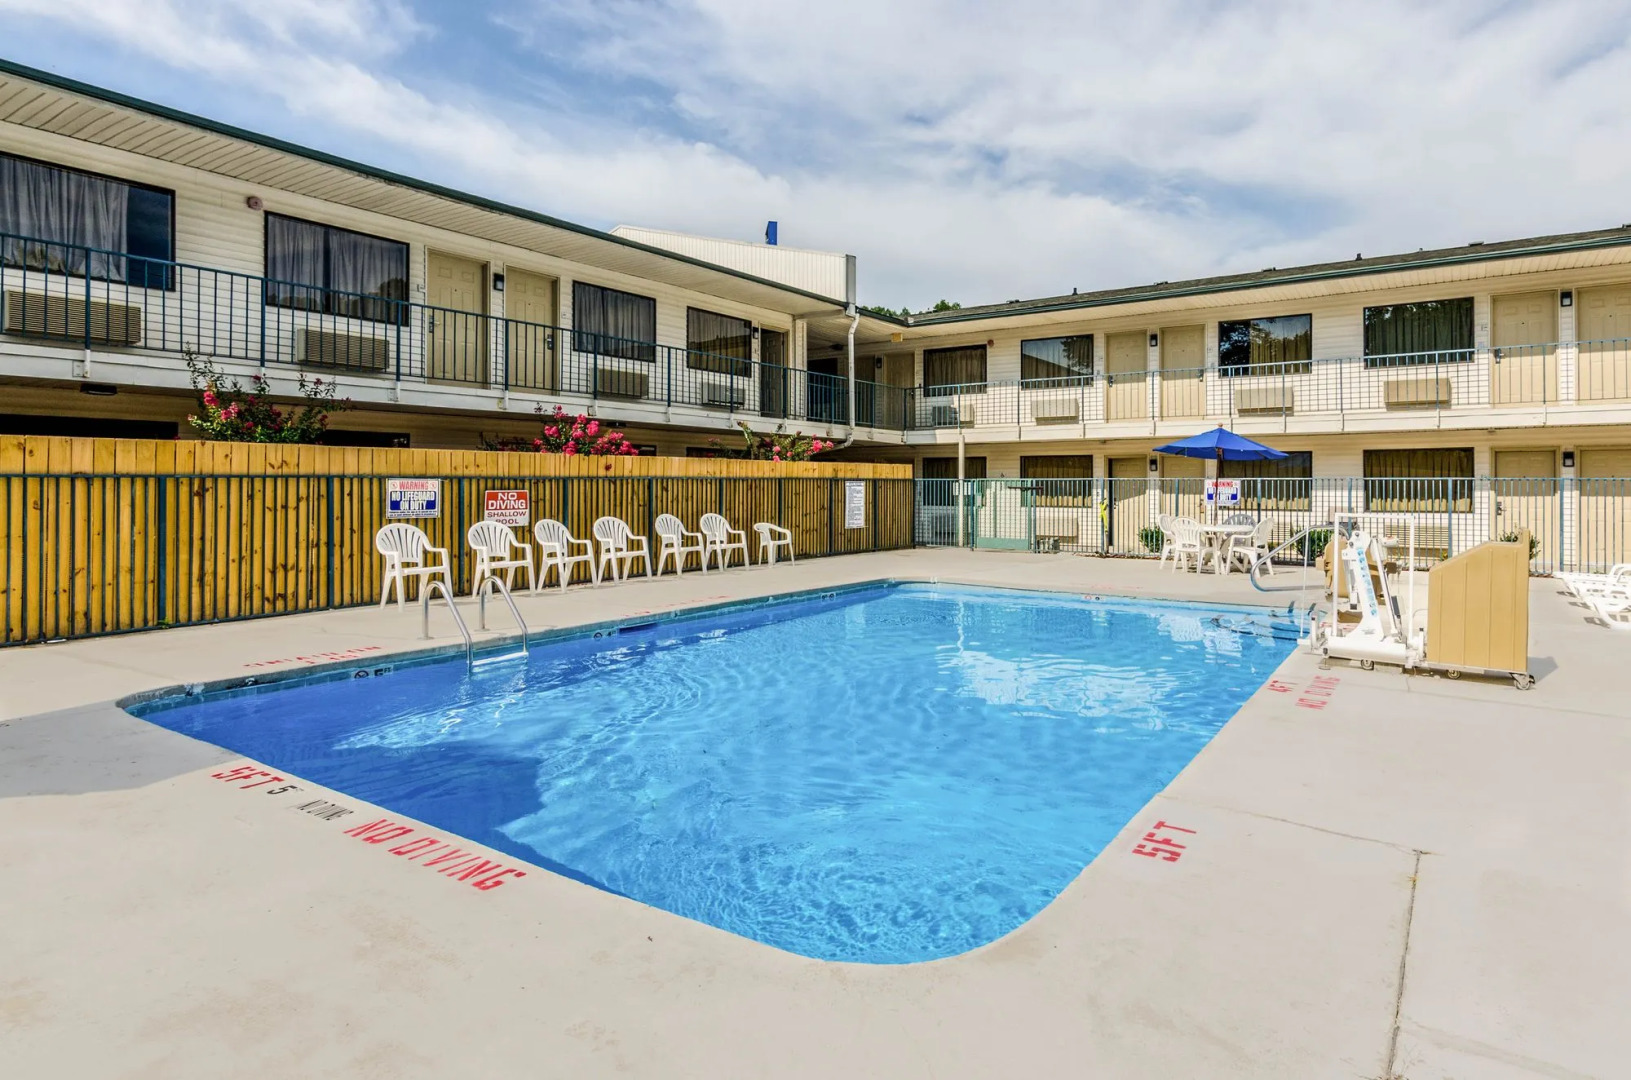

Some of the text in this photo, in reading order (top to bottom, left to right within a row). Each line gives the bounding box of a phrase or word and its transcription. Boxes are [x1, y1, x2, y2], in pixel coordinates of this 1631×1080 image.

[399, 480, 429, 490] WARNING
[391, 491, 435, 502] NO LIFEGUARD
[497, 492, 518, 501] NO
[400, 500, 427, 511] ON DUTY
[488, 500, 527, 510] DIVING
[487, 510, 527, 518] SHALLOW
[211, 766, 285, 789] 5FT
[1131, 820, 1197, 862] 5FT
[342, 818, 527, 891] NO DIVING
